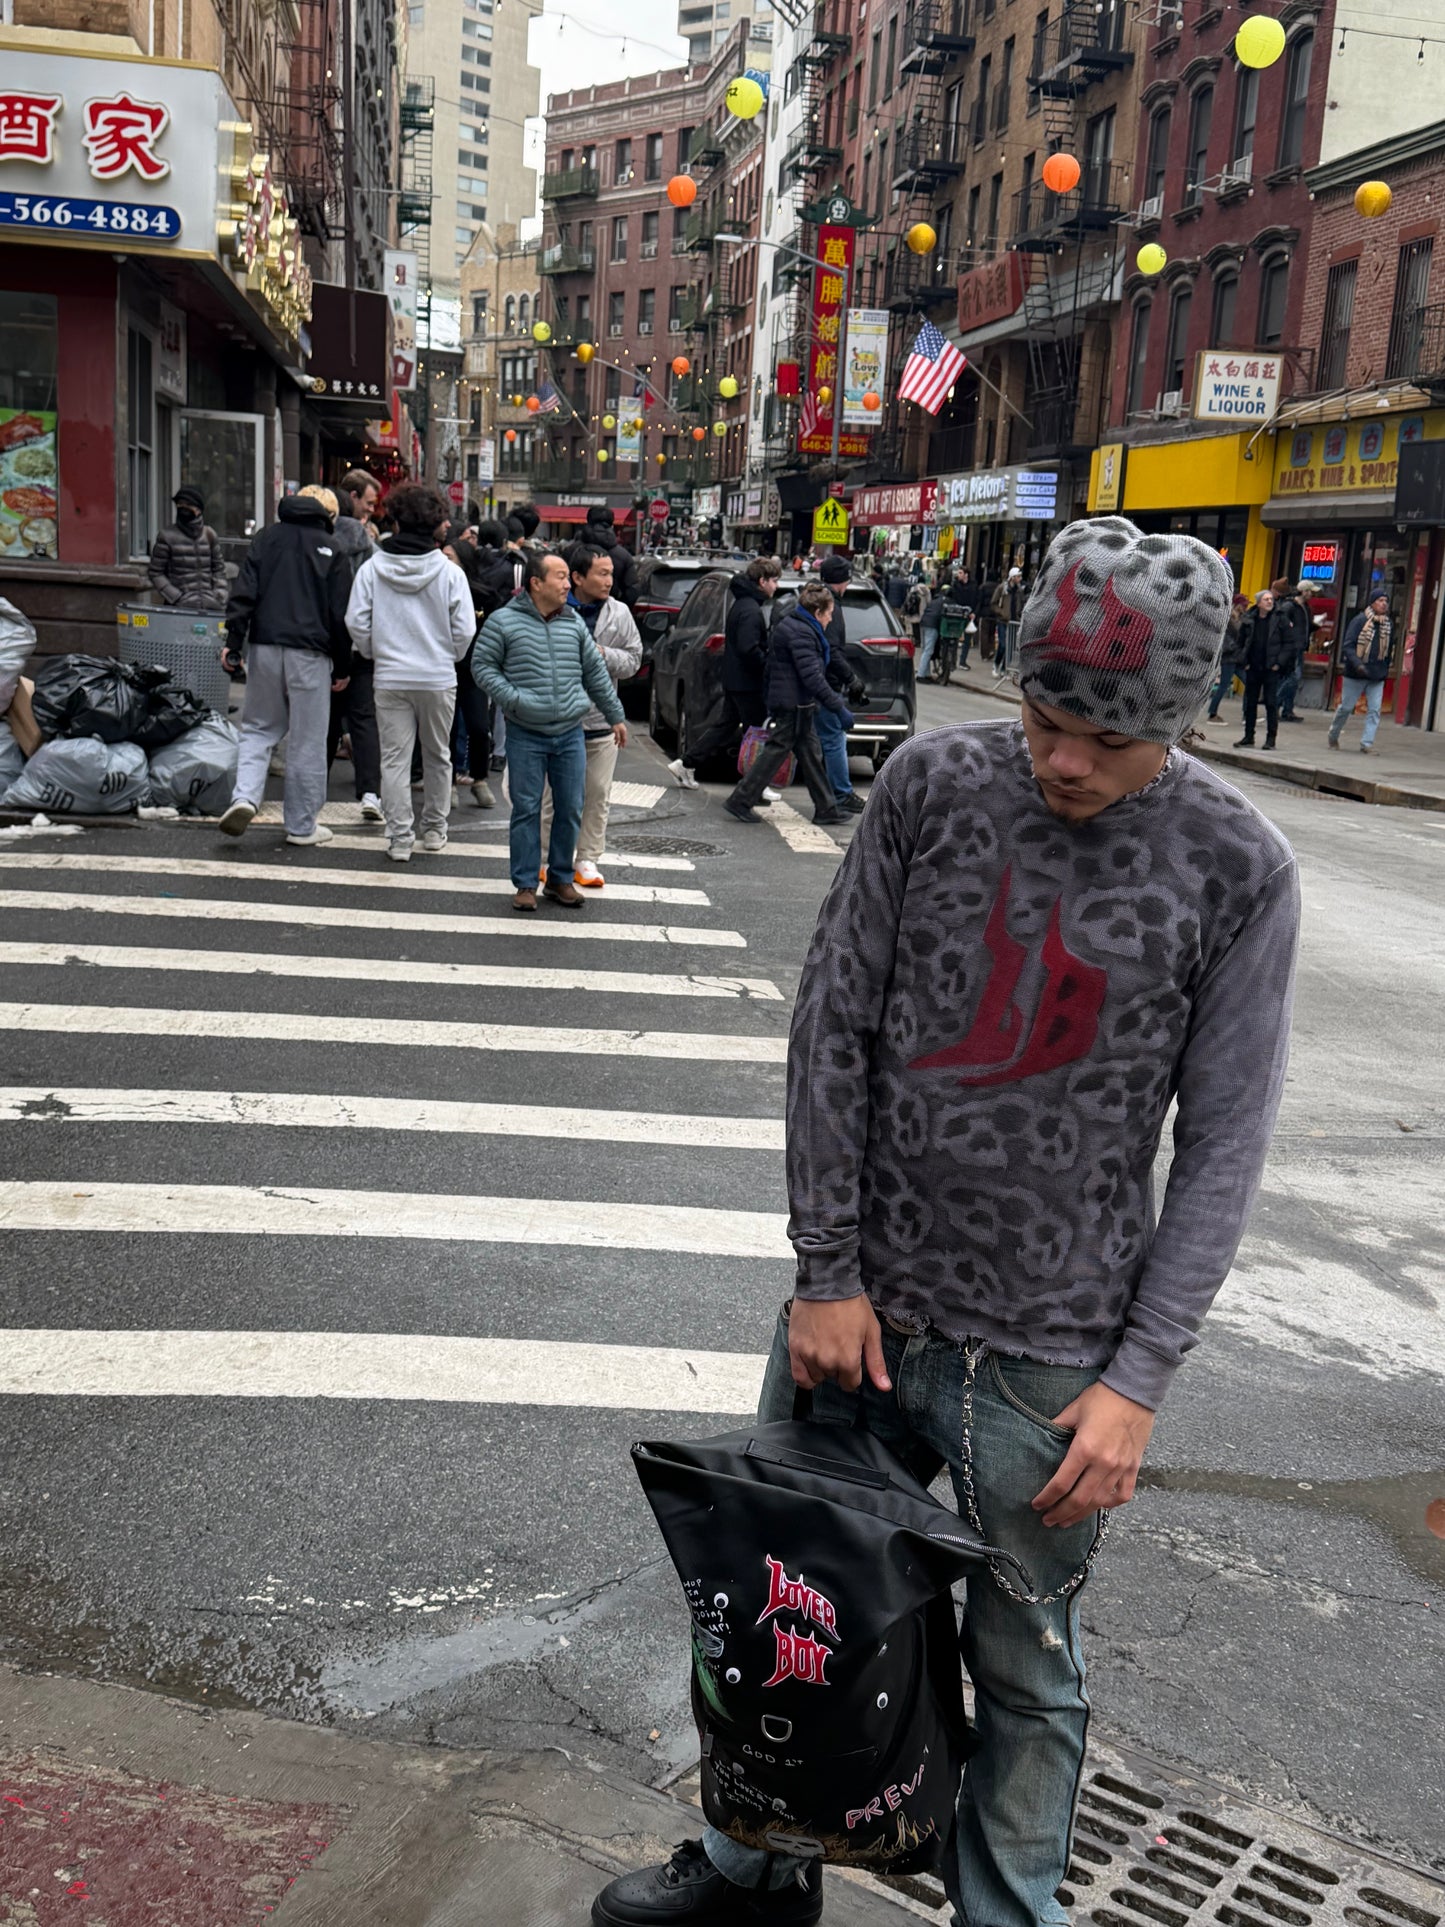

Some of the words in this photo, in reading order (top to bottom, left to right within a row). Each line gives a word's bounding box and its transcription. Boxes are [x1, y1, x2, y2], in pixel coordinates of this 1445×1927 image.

[854, 362, 879, 372] Love
[1213, 384, 1250, 398] WINE
[1256, 386, 1264, 398] &
[1208, 400, 1266, 414] LIQUOR
[1279, 469, 1315, 490] MARK'S
[1320, 466, 1344, 488] WINE
[1361, 461, 1397, 485] SPIRIT
[969, 475, 1001, 502] Melon
[651, 505, 668, 514] STOP
[1022, 509, 1048, 517] Dessert
[817, 532, 845, 540] SCHOOL
[40, 781, 75, 812] BID
[755, 1553, 841, 1641] LOVER
[762, 1618, 833, 1687] BOY
